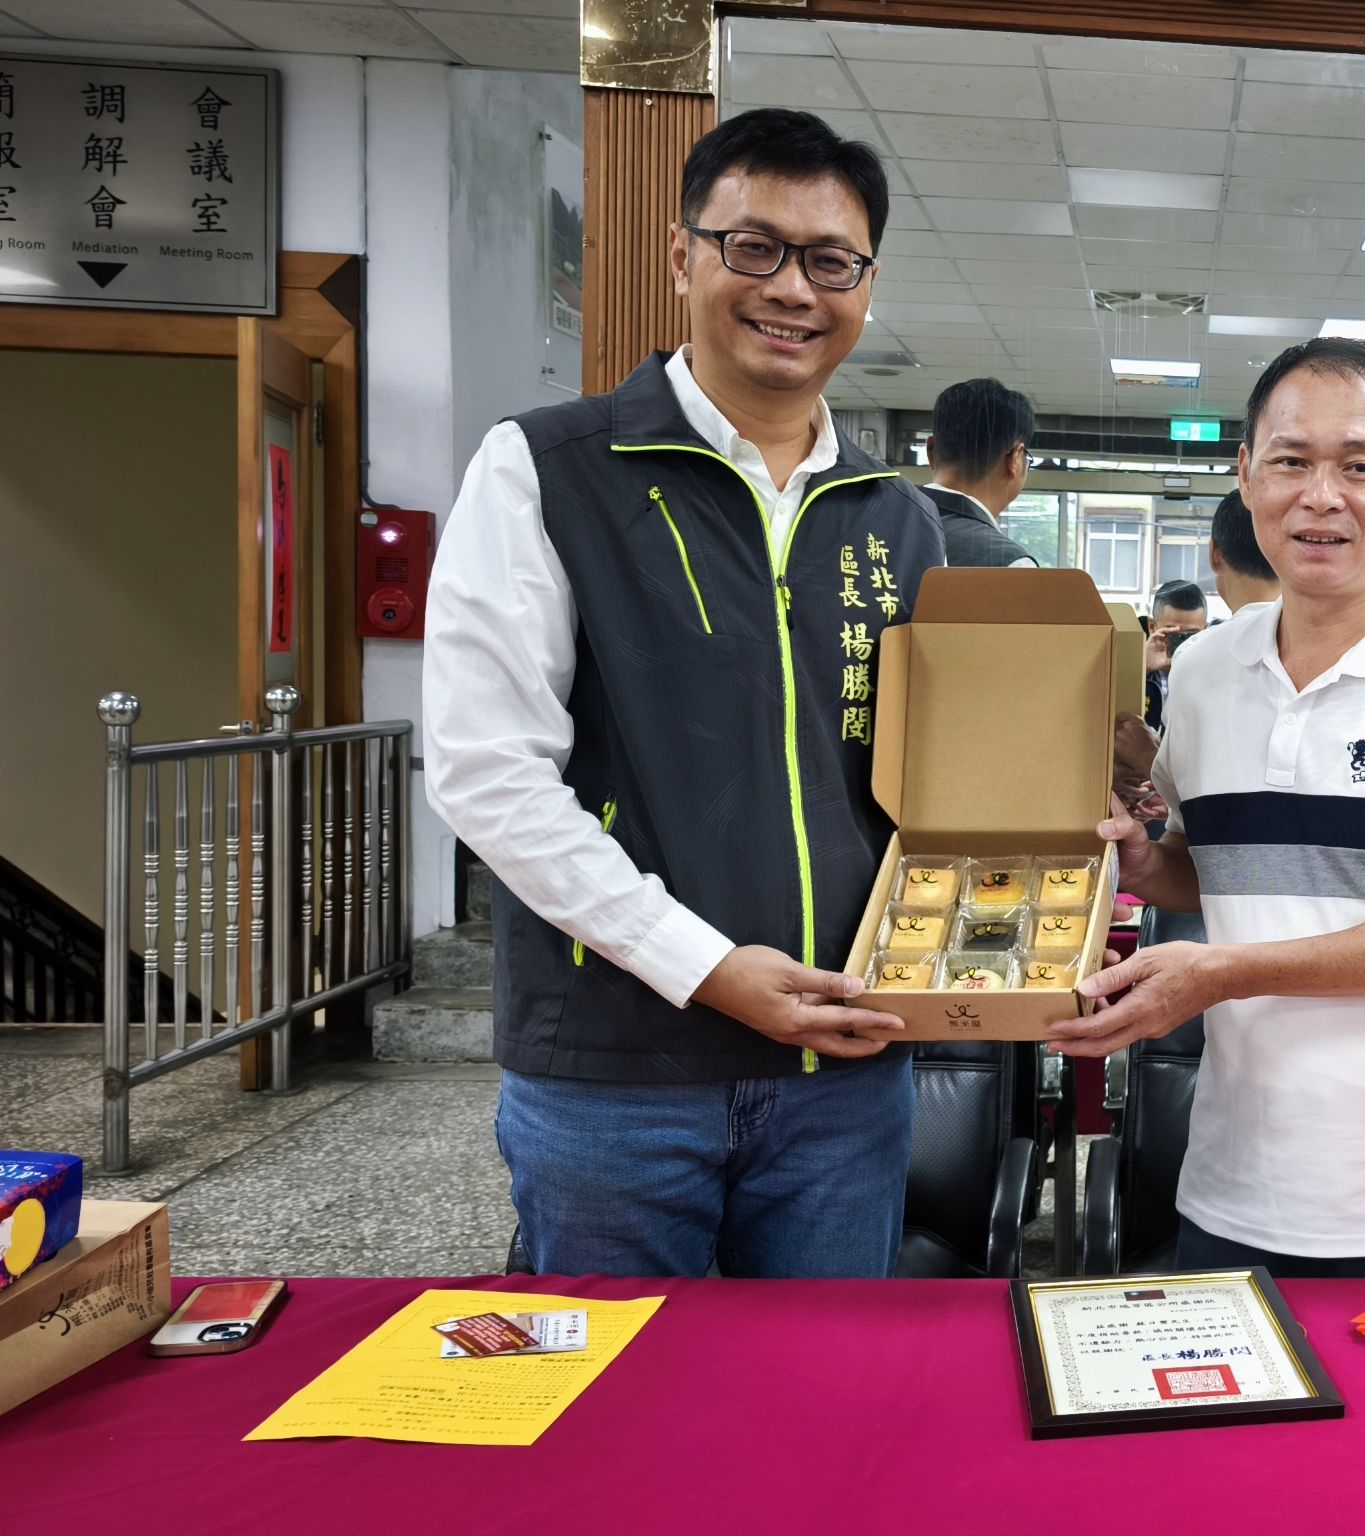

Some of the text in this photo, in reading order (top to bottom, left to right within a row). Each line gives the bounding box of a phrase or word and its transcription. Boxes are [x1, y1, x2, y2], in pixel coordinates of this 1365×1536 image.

[80, 82, 128, 230] 調解會
[186, 85, 233, 234] 會議室
[8, 237, 46, 250] Room
[72, 240, 139, 255] Mediation
[159, 245, 254, 262] Meeting Room
[866, 532, 899, 623] 新北市
[838, 545, 875, 746] 區長 楊勝閔
